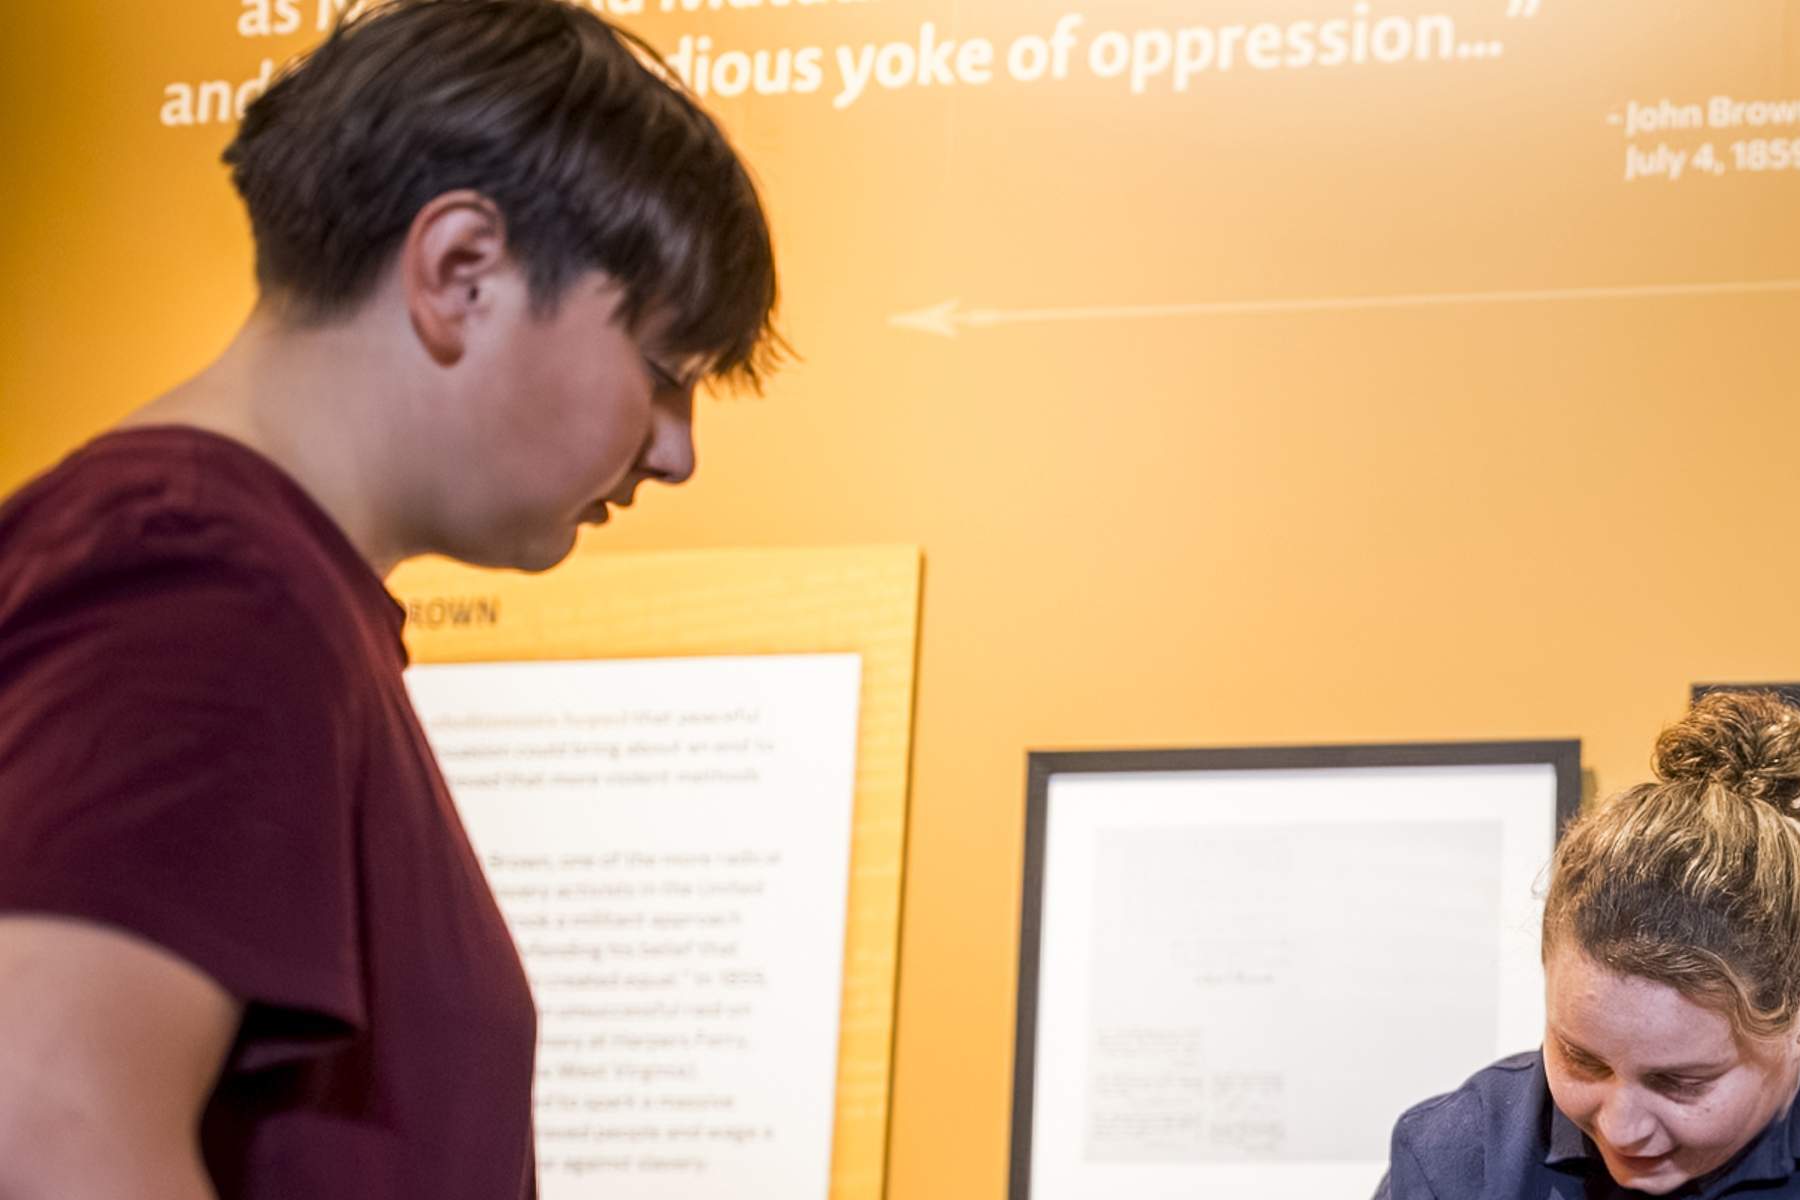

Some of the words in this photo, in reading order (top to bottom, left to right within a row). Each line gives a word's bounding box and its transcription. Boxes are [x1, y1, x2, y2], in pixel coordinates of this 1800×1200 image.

[237, 0, 302, 37] as
[668, 34, 822, 98] dious
[832, 22, 994, 110] yoke
[1005, 13, 1084, 83] of
[1625, 98, 1702, 136] John
[1625, 141, 1685, 182] July
[408, 595, 499, 630] ROWN
